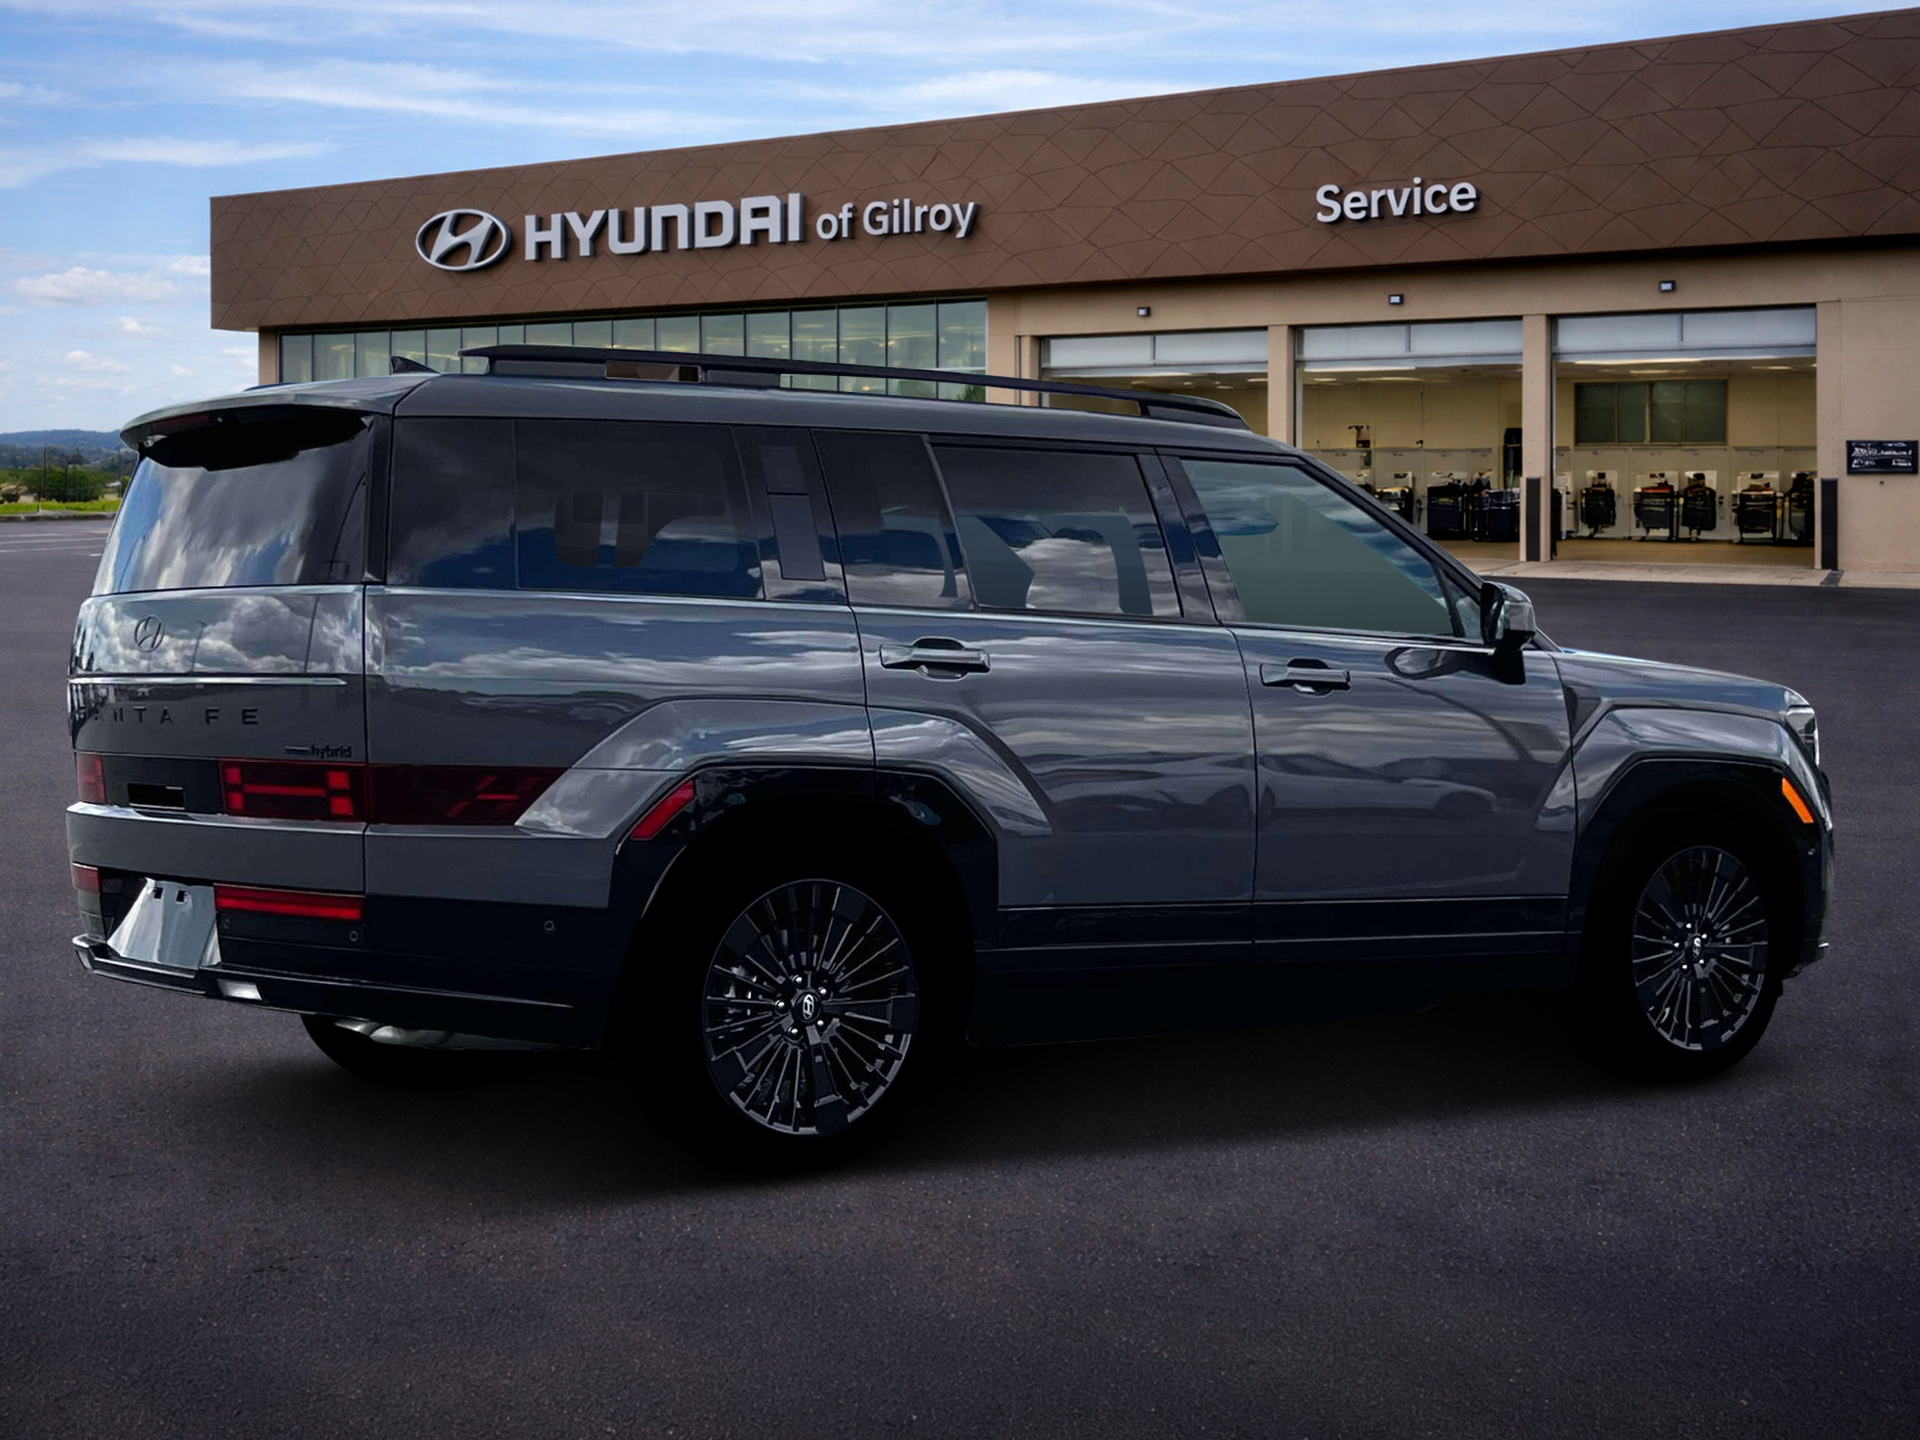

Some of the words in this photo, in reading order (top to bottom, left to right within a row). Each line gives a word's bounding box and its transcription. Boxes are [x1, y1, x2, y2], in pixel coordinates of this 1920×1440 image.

[1315, 176, 1478, 224] Service
[524, 192, 804, 262] HYUNDAI
[815, 202, 855, 241] of
[862, 198, 977, 239] Gilroy
[77, 705, 174, 724] NTA
[204, 707, 260, 725] FE
[310, 743, 353, 759] hybrid
